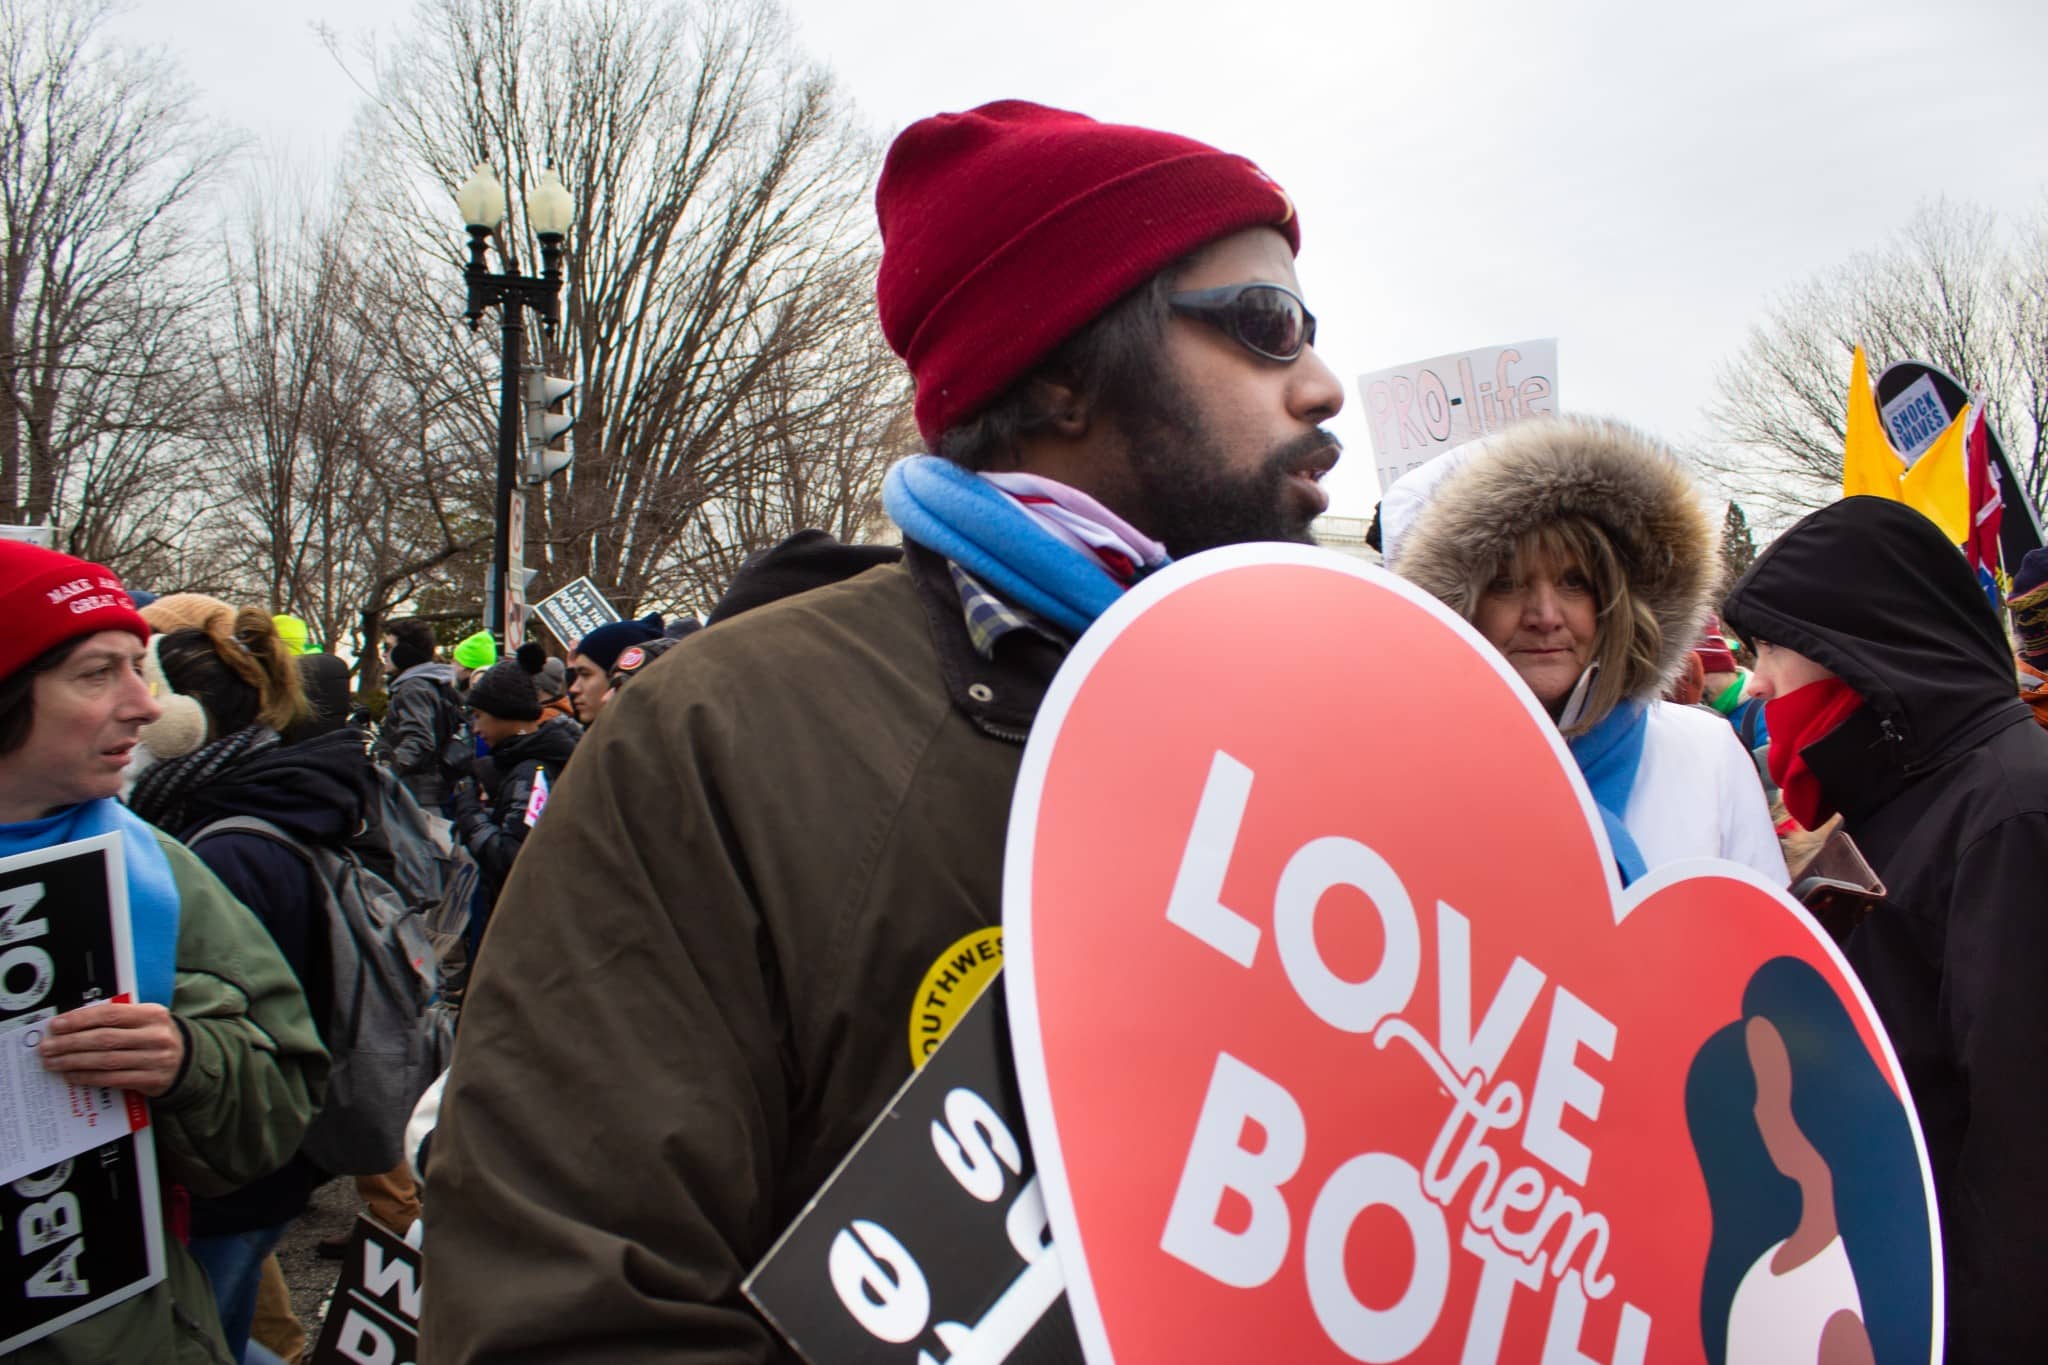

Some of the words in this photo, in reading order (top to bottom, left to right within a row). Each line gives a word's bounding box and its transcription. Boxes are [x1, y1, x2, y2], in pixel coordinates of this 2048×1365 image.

[1367, 348, 1551, 454] PRO-life
[1892, 390, 1937, 435] SHOCK
[1899, 409, 1945, 451] WAVES
[46, 578, 95, 605] MAKE
[574, 593, 592, 609] AM
[588, 608, 608, 627] THE
[1165, 748, 1619, 1188] LOVE
[1373, 1017, 1617, 1300] them
